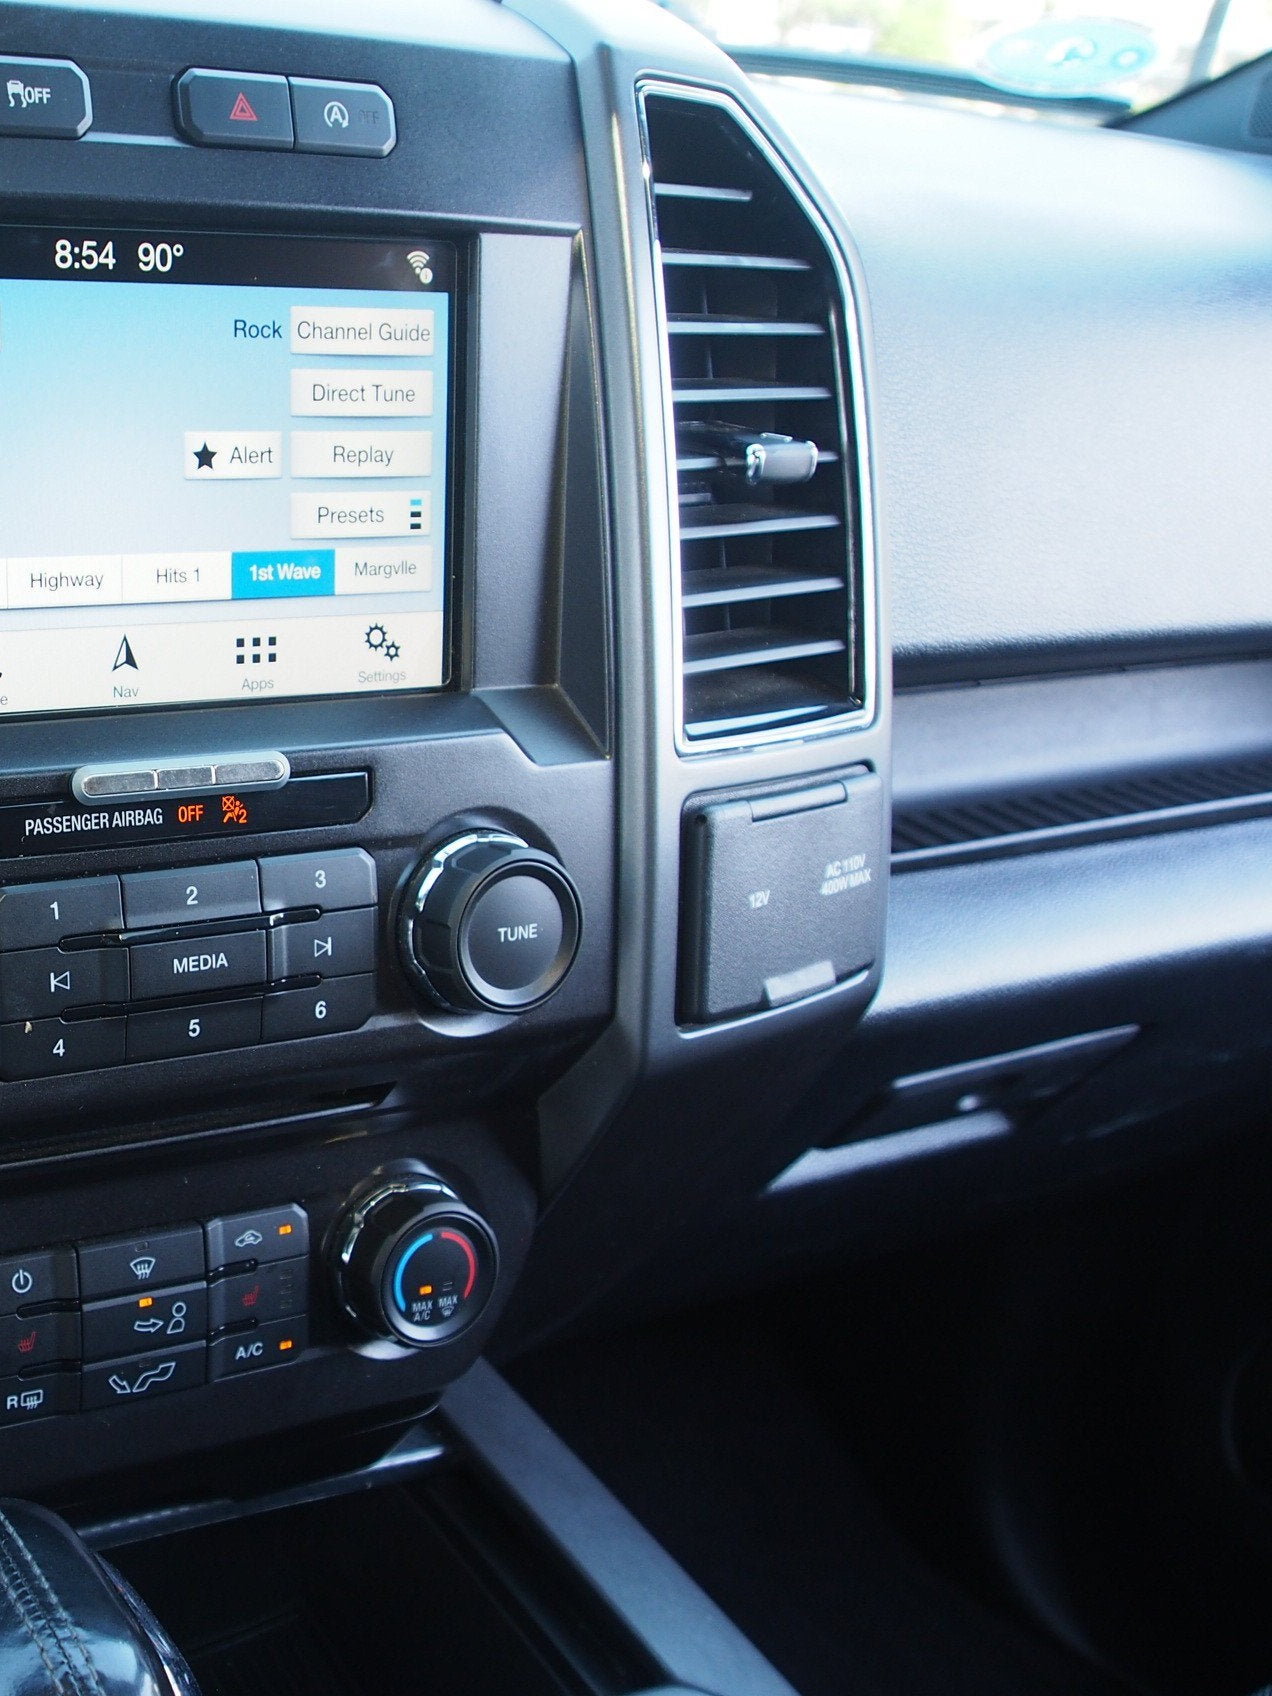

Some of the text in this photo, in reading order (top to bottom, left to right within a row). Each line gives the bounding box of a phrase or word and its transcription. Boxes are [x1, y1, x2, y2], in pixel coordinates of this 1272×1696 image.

[24, 86, 51, 104] OFF
[54, 239, 117, 270] 8:54
[233, 318, 283, 339] Rock
[296, 320, 431, 343] Channel Guide
[312, 383, 416, 402] Direct Tune
[229, 446, 274, 464] Alert
[332, 445, 395, 467] Replay
[316, 506, 385, 525] Presets
[155, 567, 202, 584] Hits 1
[249, 563, 322, 581] 1st Wave
[354, 561, 418, 579] Margvlle
[29, 572, 105, 592] Highway
[241, 678, 275, 693] Apps
[357, 669, 407, 684] Settings
[112, 686, 139, 698] Nav
[24, 808, 164, 836] PASSENGER AIRBAG
[178, 804, 204, 823] OFF
[314, 869, 327, 889] 3
[824, 860, 842, 879] AC
[849, 868, 872, 888] MAX
[185, 886, 199, 905] 2
[749, 889, 771, 909] 12V
[50, 901, 59, 921] 1
[497, 922, 538, 942] TUNE
[172, 952, 229, 974] MEDIA
[314, 1000, 327, 1019] 6
[188, 1018, 201, 1037] 5
[52, 1040, 66, 1058] 4
[412, 1300, 434, 1313] MAX
[438, 1294, 459, 1308] MAX
[413, 1310, 432, 1322] A/C
[235, 1342, 264, 1360] A/C
[6, 1395, 18, 1409] R
